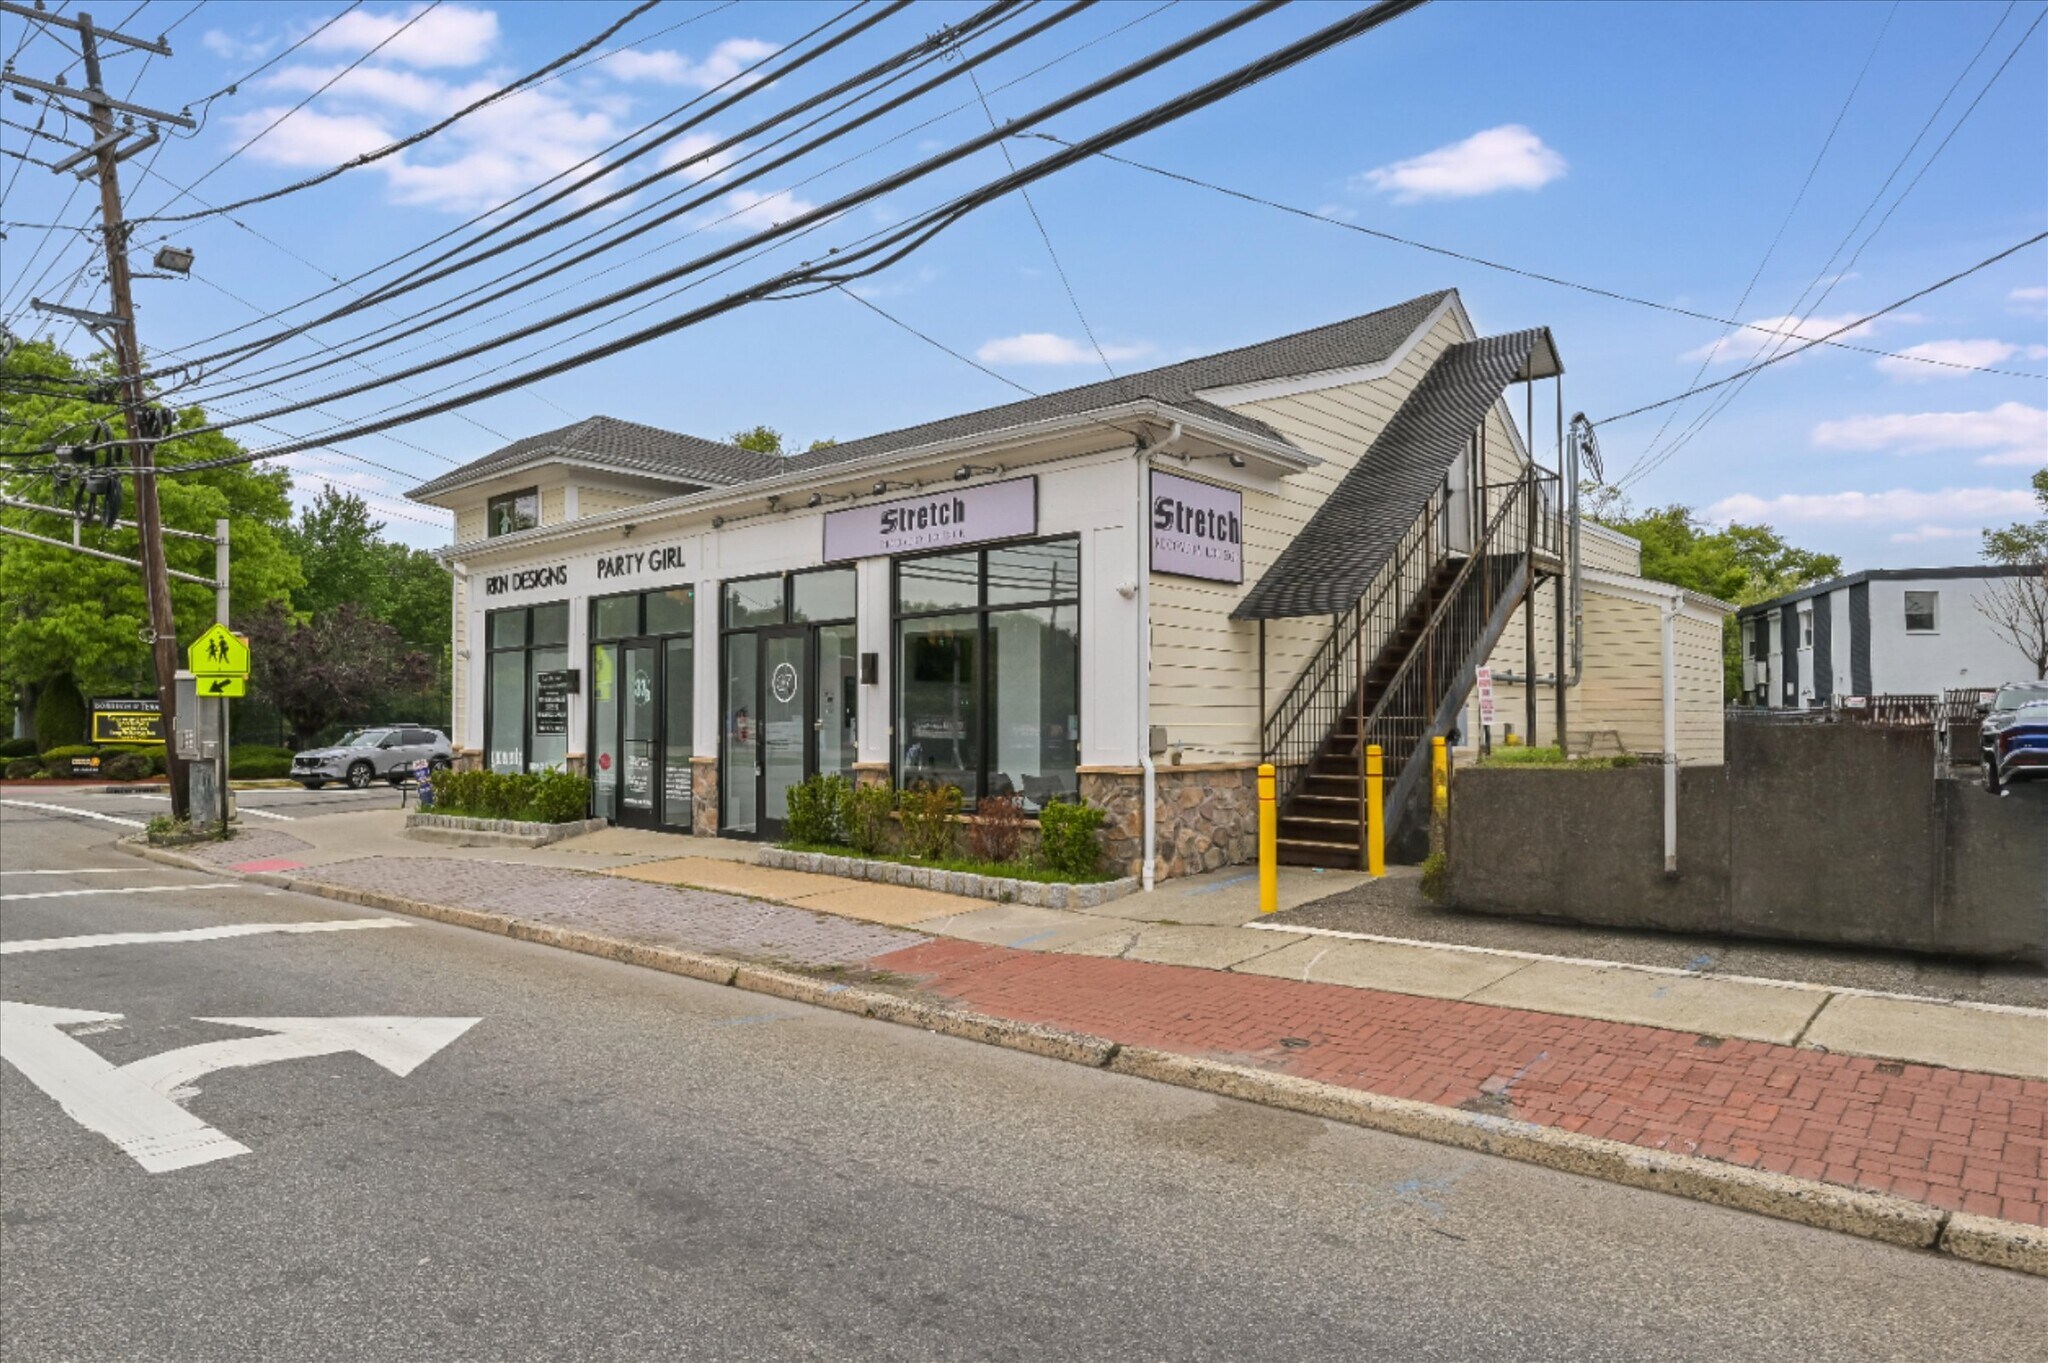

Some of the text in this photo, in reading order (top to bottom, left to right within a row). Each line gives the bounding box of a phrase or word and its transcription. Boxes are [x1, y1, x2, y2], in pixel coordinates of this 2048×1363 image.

[880, 497, 965, 535] Stretch
[1153, 495, 1240, 545] Stretch
[512, 564, 567, 592] DESIGNS
[597, 545, 686, 580] PARTY GIRL
